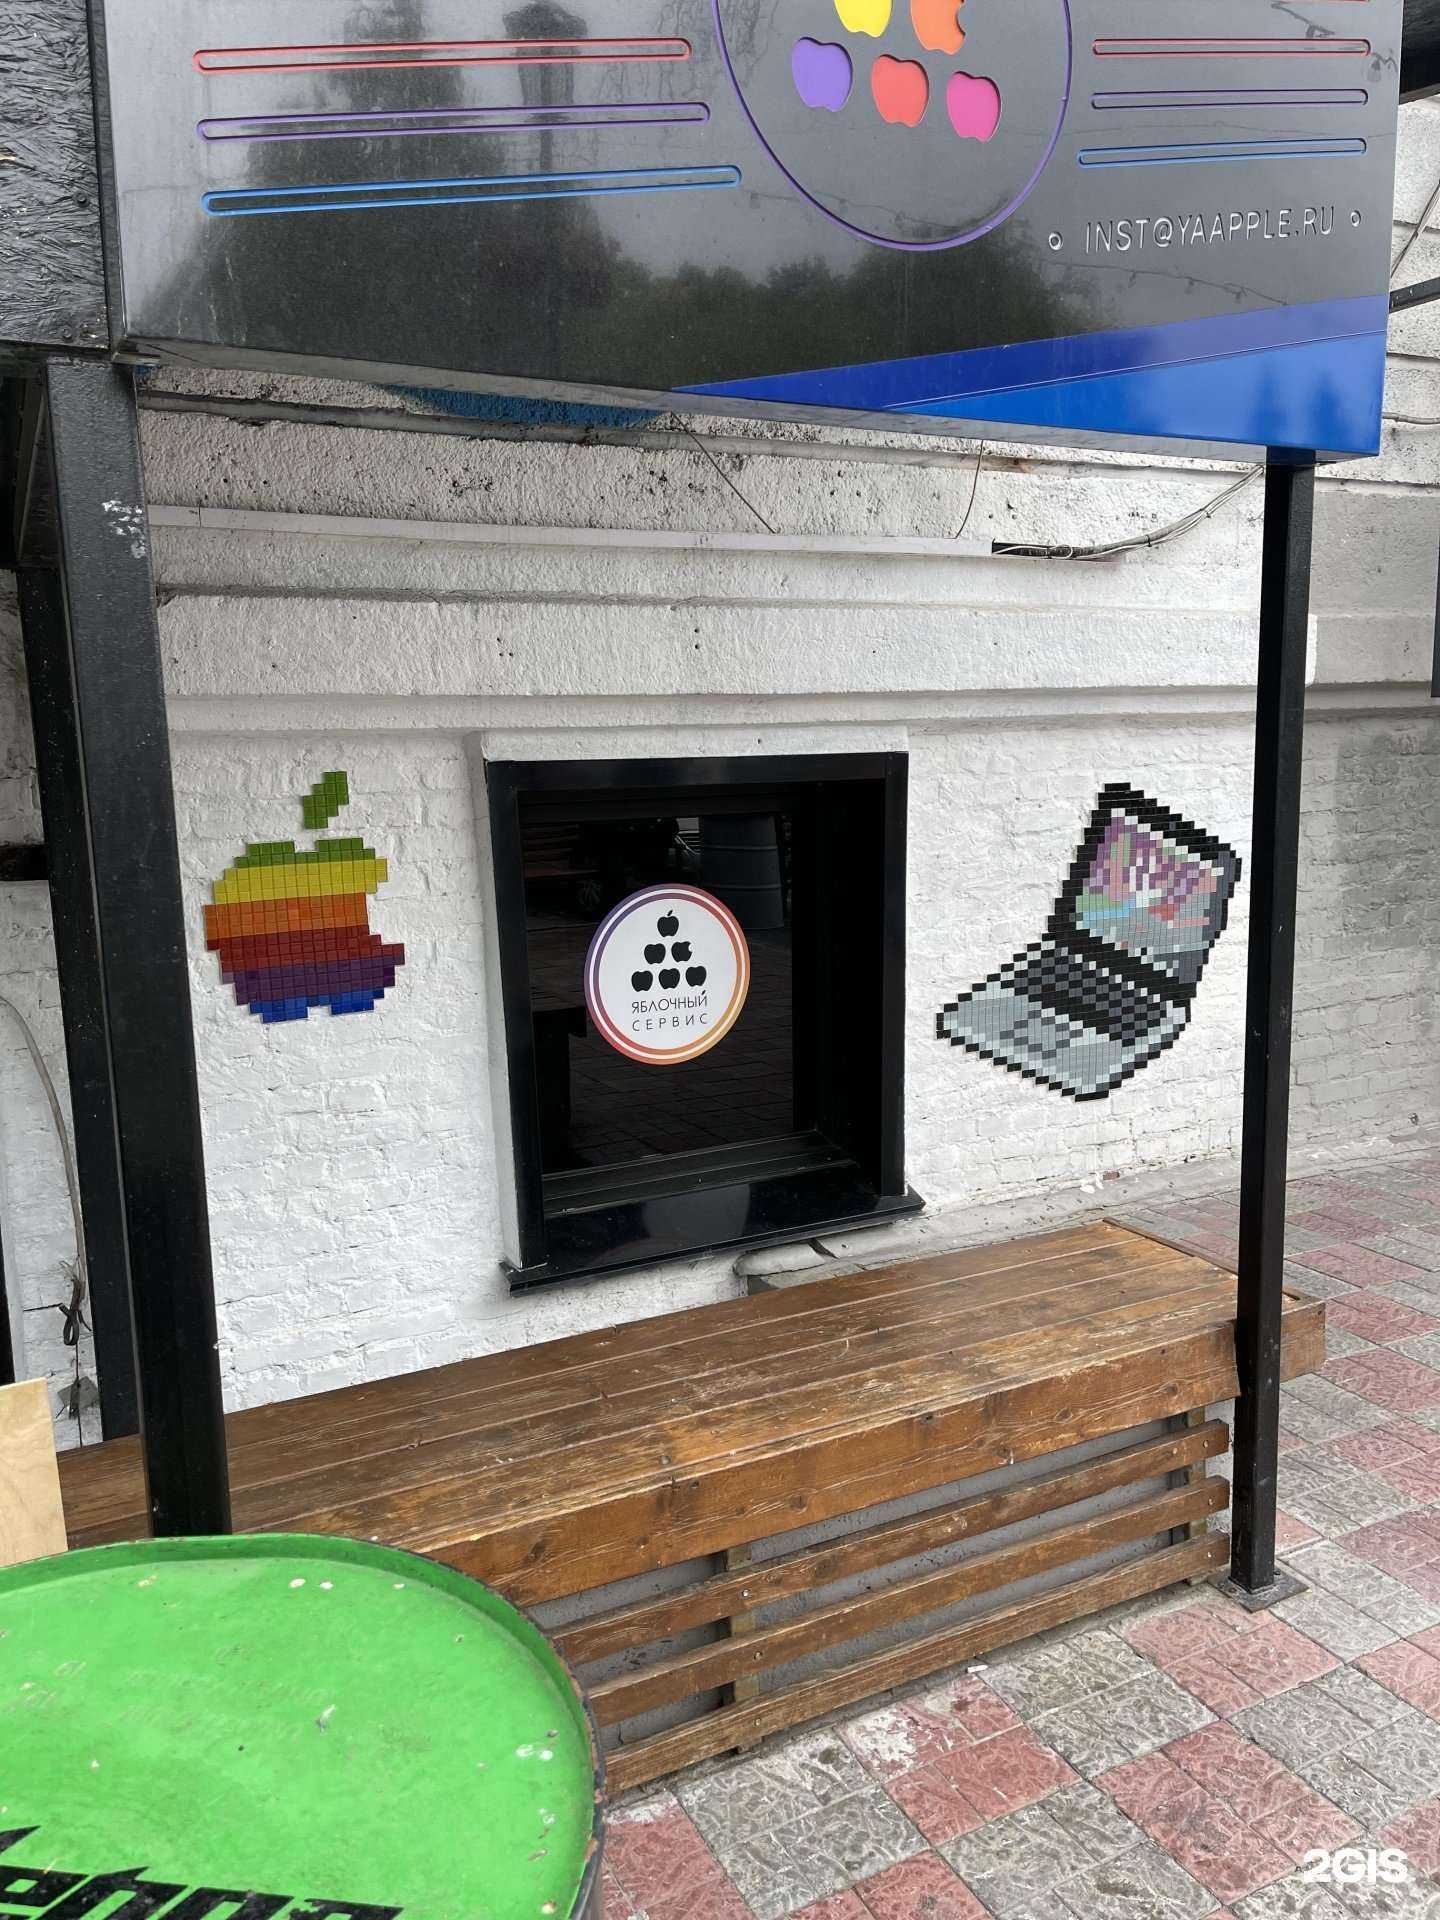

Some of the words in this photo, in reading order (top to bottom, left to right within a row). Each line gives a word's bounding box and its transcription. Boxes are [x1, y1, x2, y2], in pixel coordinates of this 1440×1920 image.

[1085, 206, 1335, 254] INST@YAAPPLE.RU
[631, 990, 708, 1014] ЯБЛОЧНЫЙ
[632, 1013, 709, 1032] СЕРВИС
